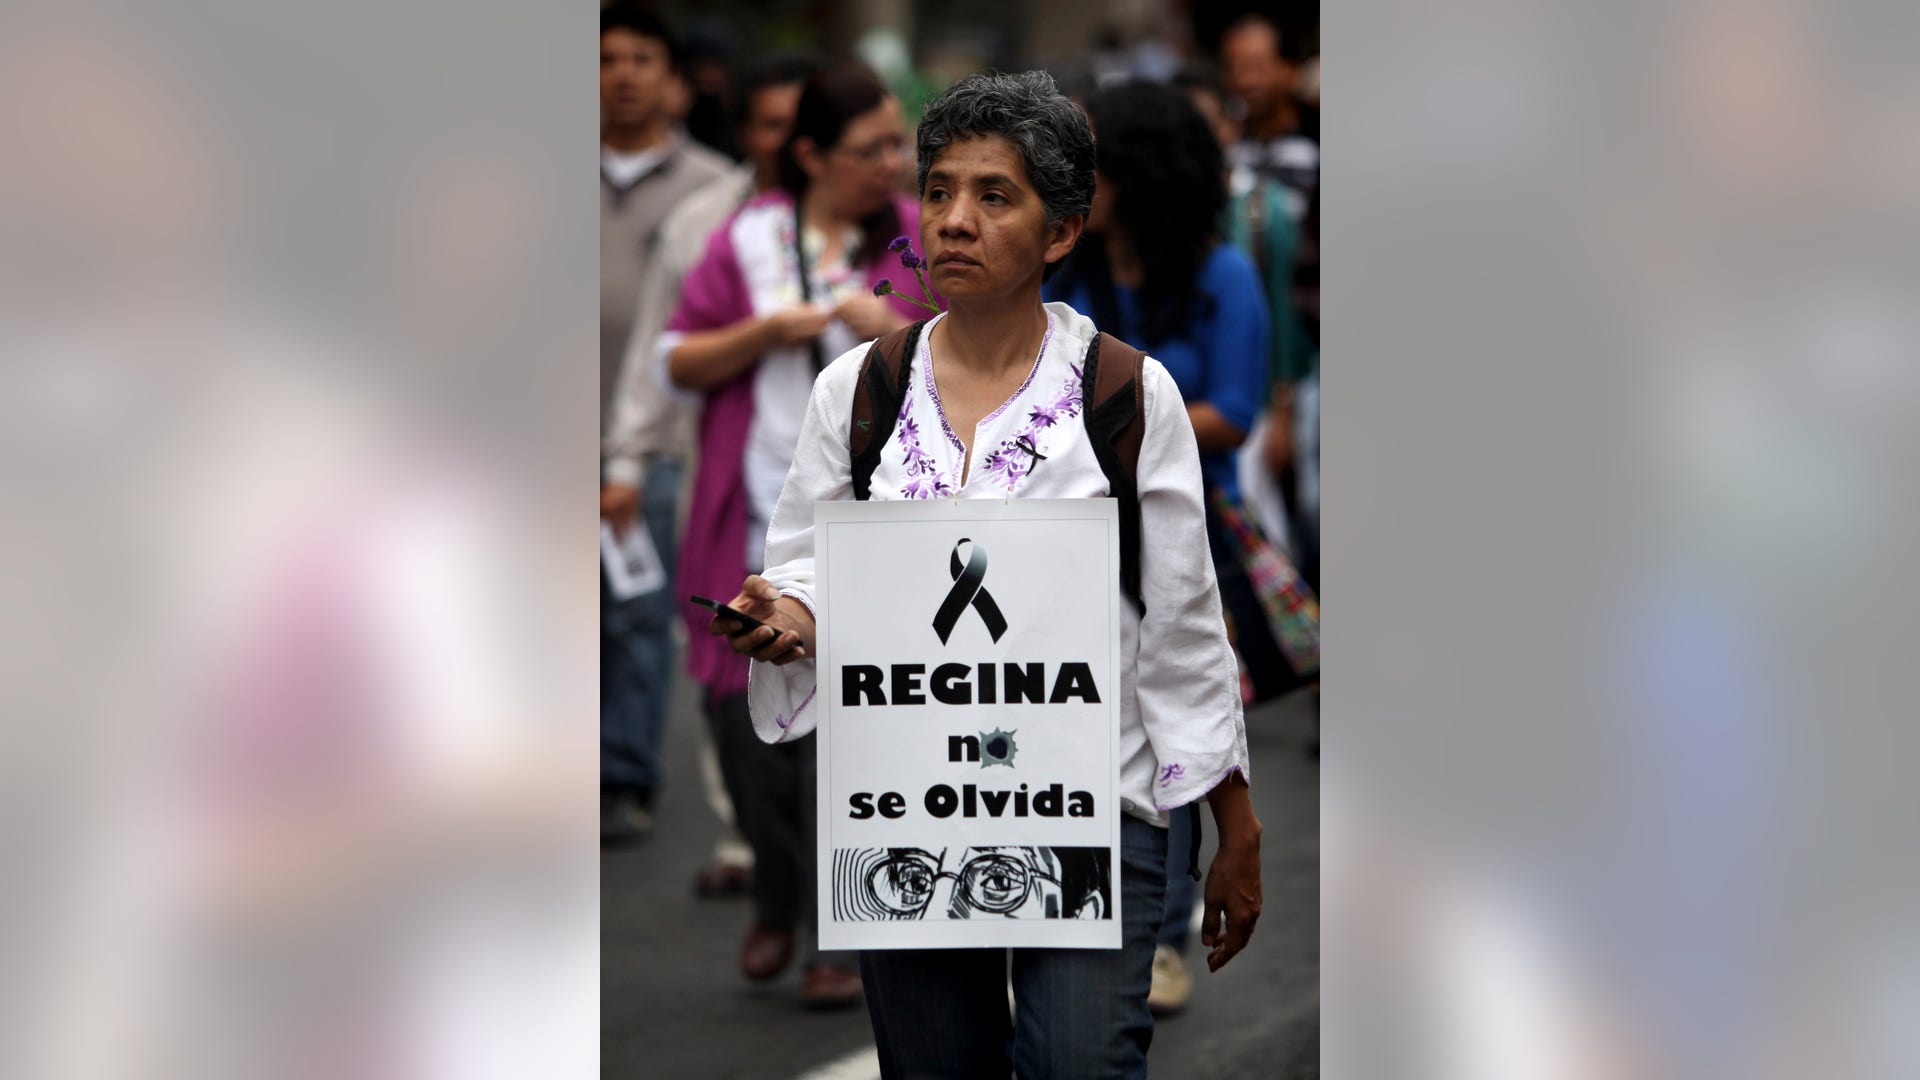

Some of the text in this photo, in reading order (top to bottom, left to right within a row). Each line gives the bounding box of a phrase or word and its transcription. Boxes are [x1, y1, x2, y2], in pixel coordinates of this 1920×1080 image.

[842, 662, 1102, 706] REGINA
[849, 783, 1095, 819] se Olvida
